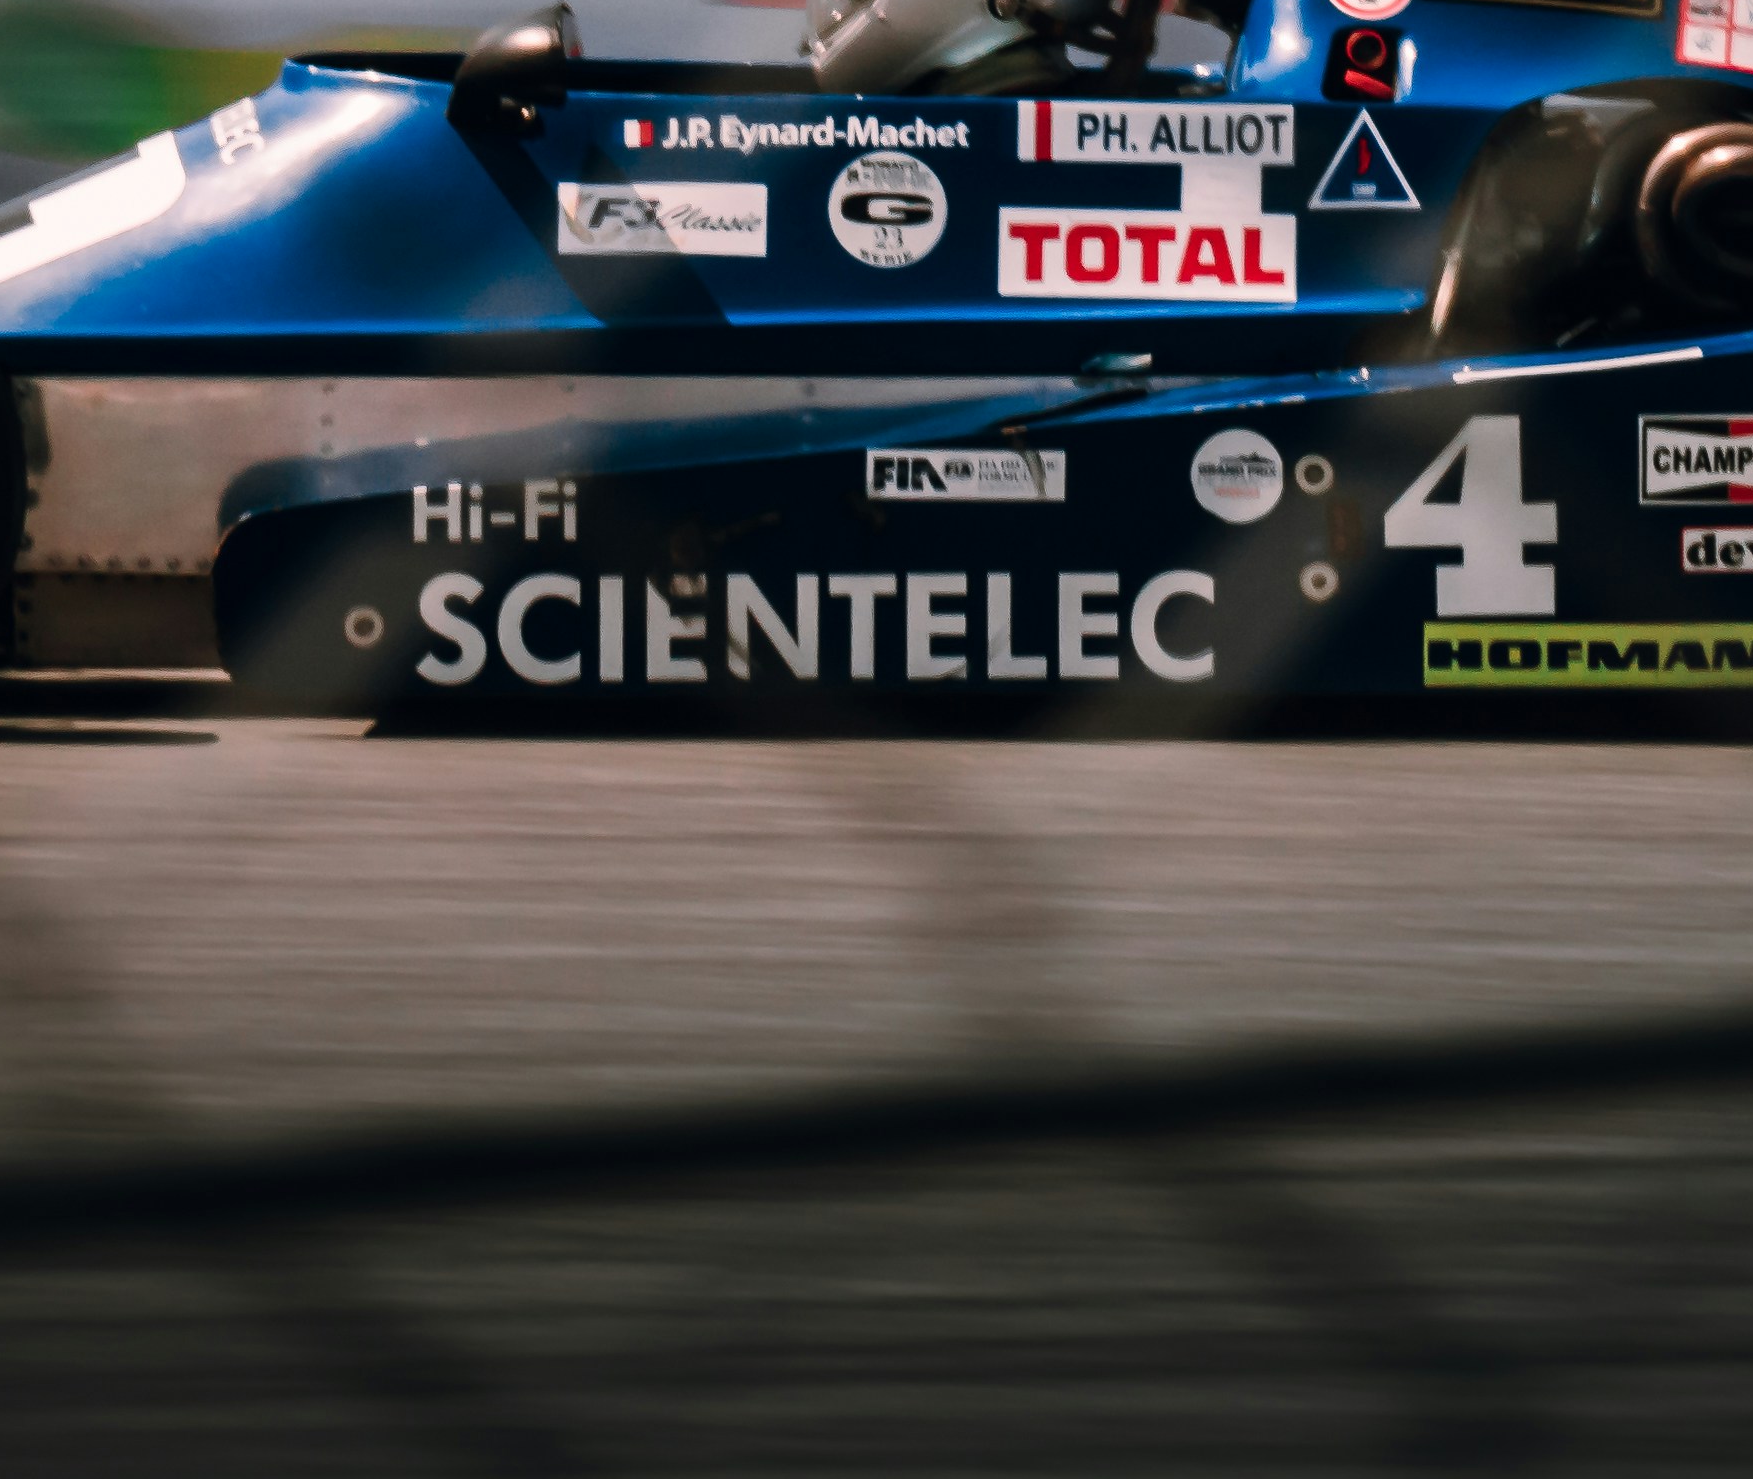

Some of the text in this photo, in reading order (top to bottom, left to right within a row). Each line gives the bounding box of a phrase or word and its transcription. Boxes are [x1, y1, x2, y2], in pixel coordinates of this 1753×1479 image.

[720, 114, 970, 155] Eynard-Machet
[1077, 113, 1288, 157] PH. ALLIOT
[1008, 222, 1286, 286] TOTAL
[873, 455, 948, 492] FIA
[411, 479, 578, 543] Hi-Fi
[1385, 415, 1558, 617] 4
[415, 569, 1216, 685] SCIENTELEC
